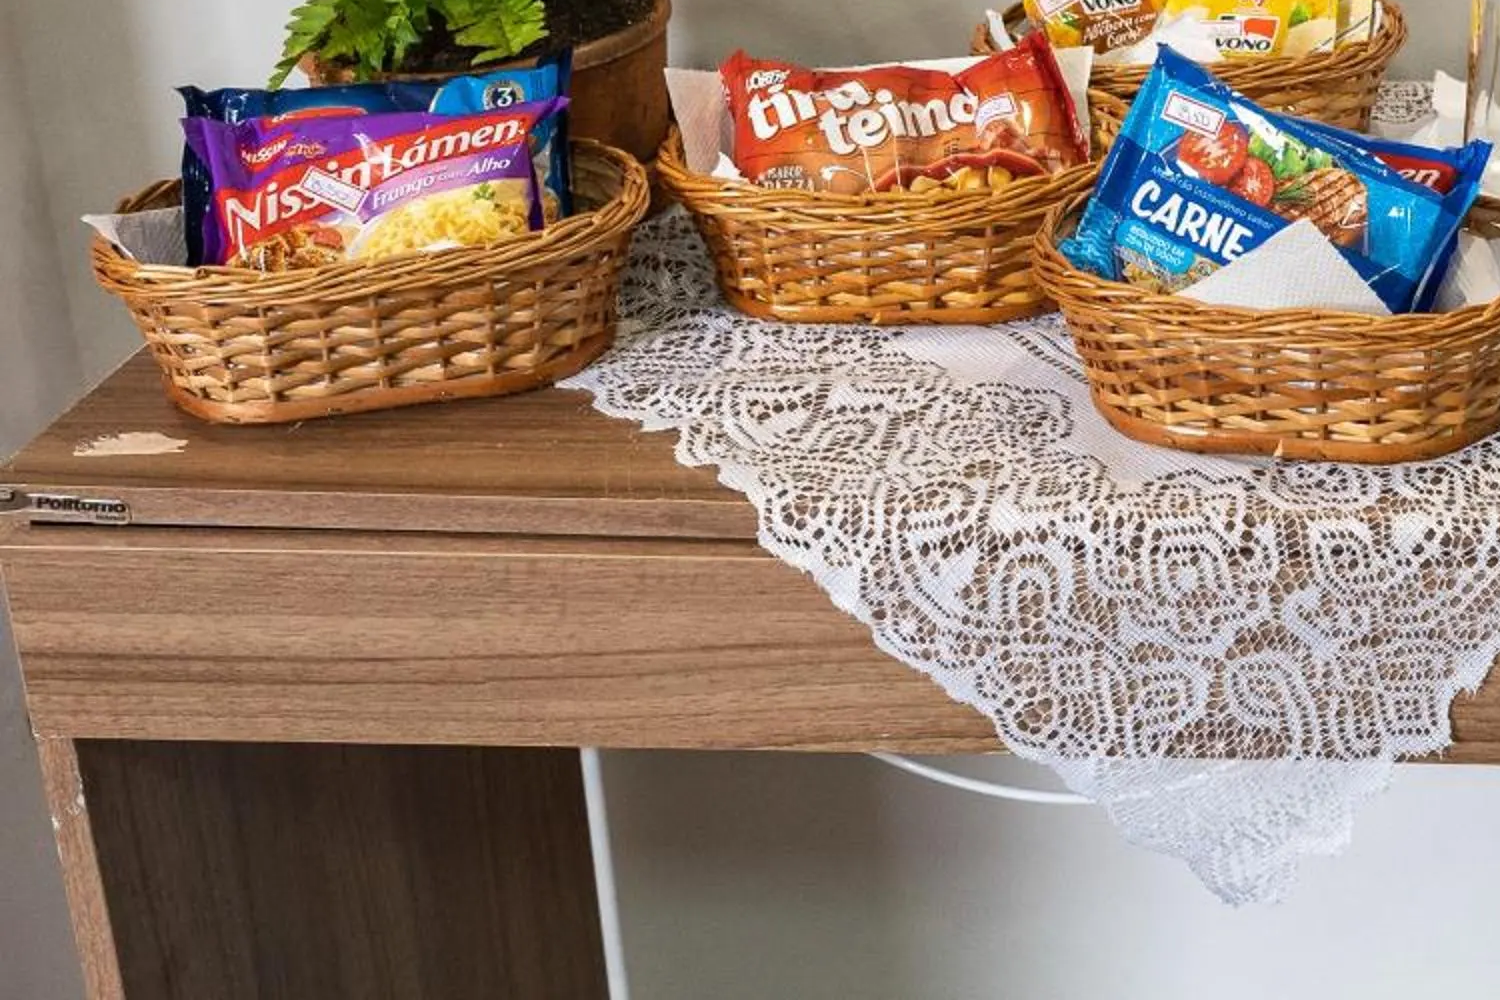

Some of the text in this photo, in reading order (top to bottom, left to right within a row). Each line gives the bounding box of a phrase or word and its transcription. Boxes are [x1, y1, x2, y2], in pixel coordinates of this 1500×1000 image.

[1215, 37, 1271, 50] VONO
[749, 81, 874, 140] tira
[372, 173, 436, 210] Frango
[466, 156, 511, 178] Alho
[1131, 179, 1254, 261] CARNE
[36, 497, 127, 513] Politorno
